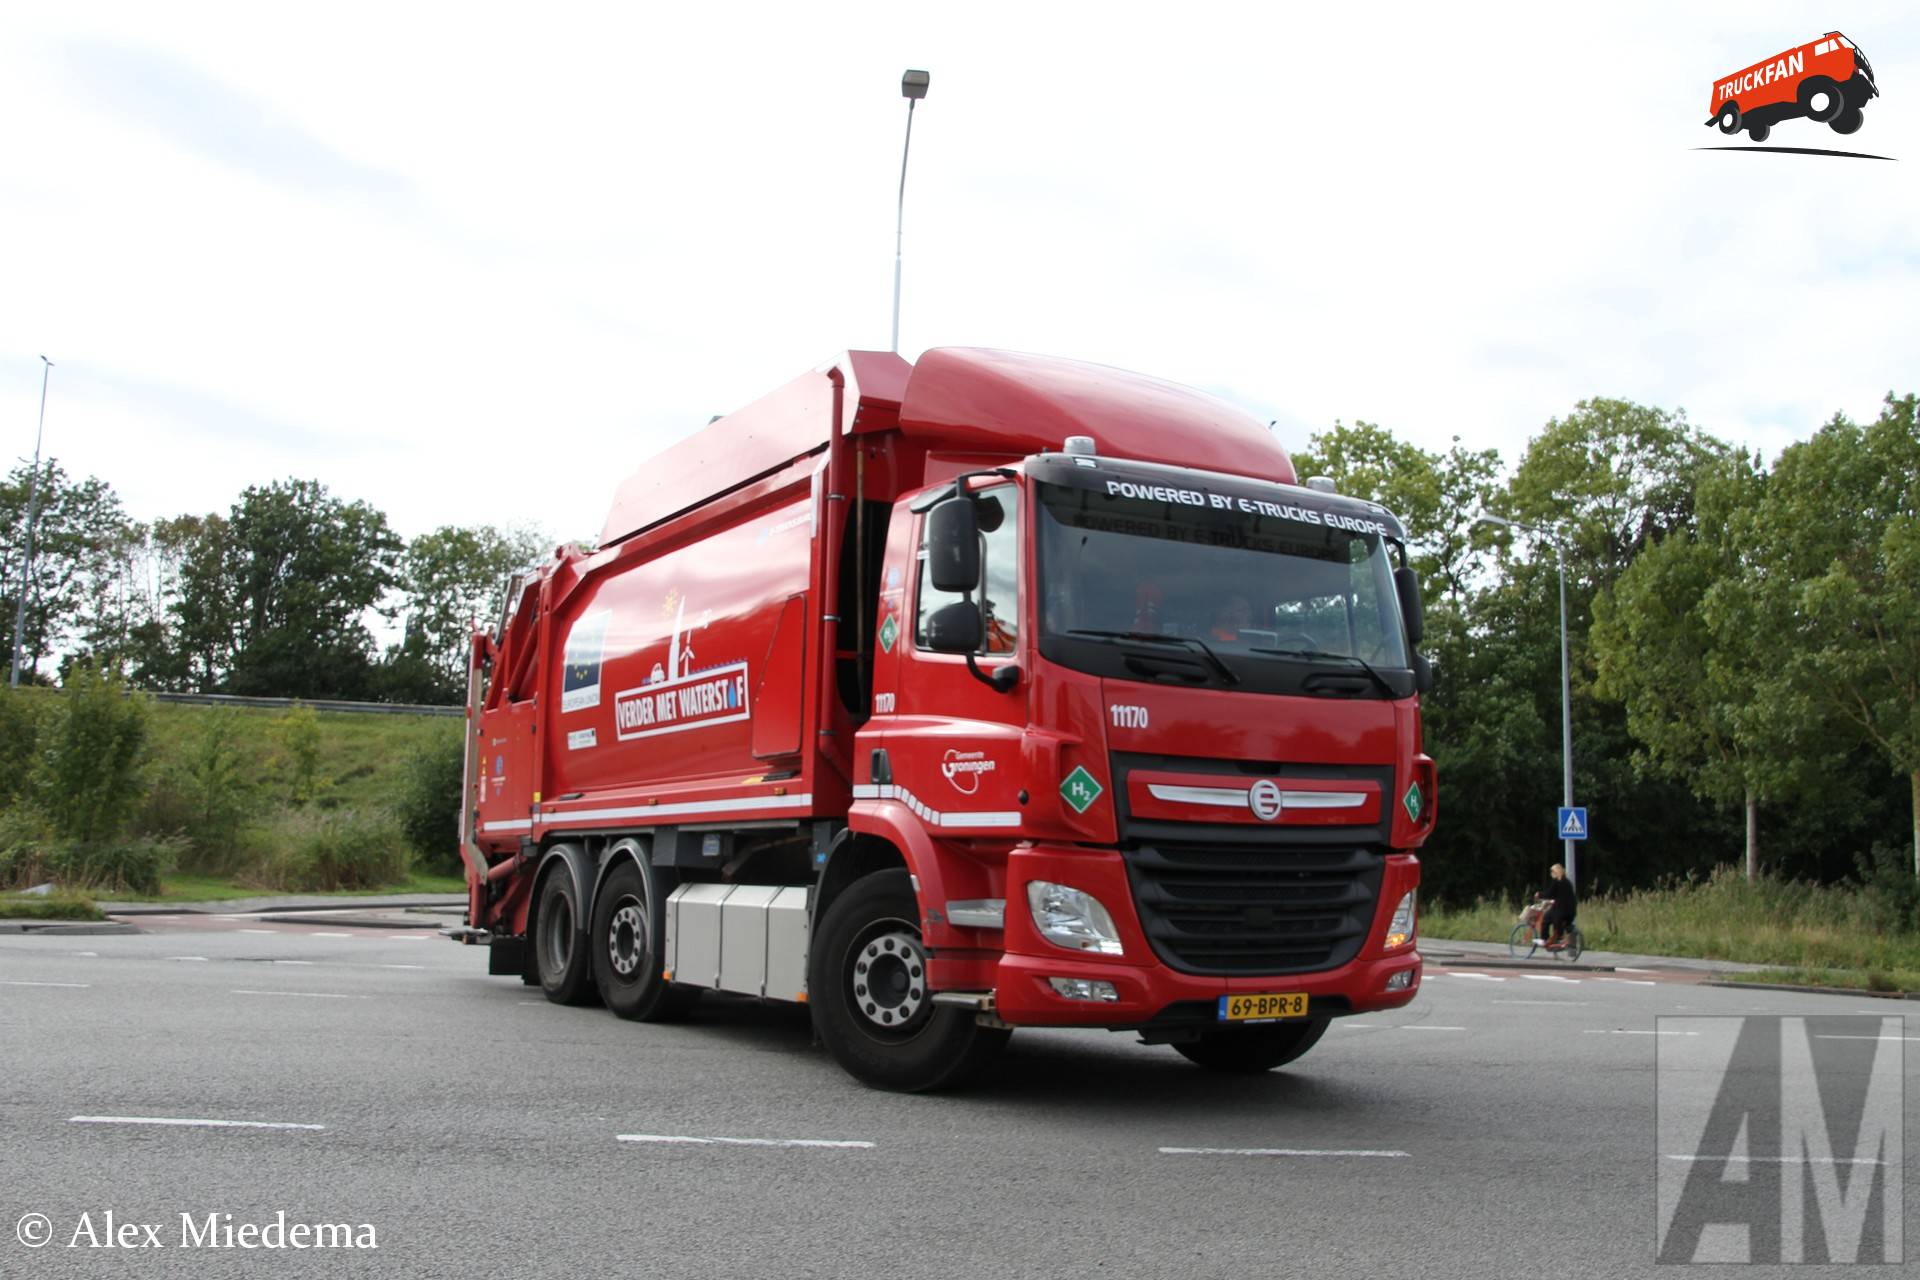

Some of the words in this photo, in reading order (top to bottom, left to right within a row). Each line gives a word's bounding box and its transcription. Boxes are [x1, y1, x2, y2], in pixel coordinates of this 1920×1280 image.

[1106, 480, 1204, 506] POWERED
[1209, 493, 1233, 510] BY
[1239, 497, 1321, 525] E-TRUCKS
[1324, 513, 1388, 537] EUROPE
[618, 696, 656, 728] VERDER
[656, 691, 677, 722] MET
[1110, 704, 1148, 729] 11170
[1072, 782, 1091, 801] H2
[1231, 997, 1302, 1016] 69-BPR-8
